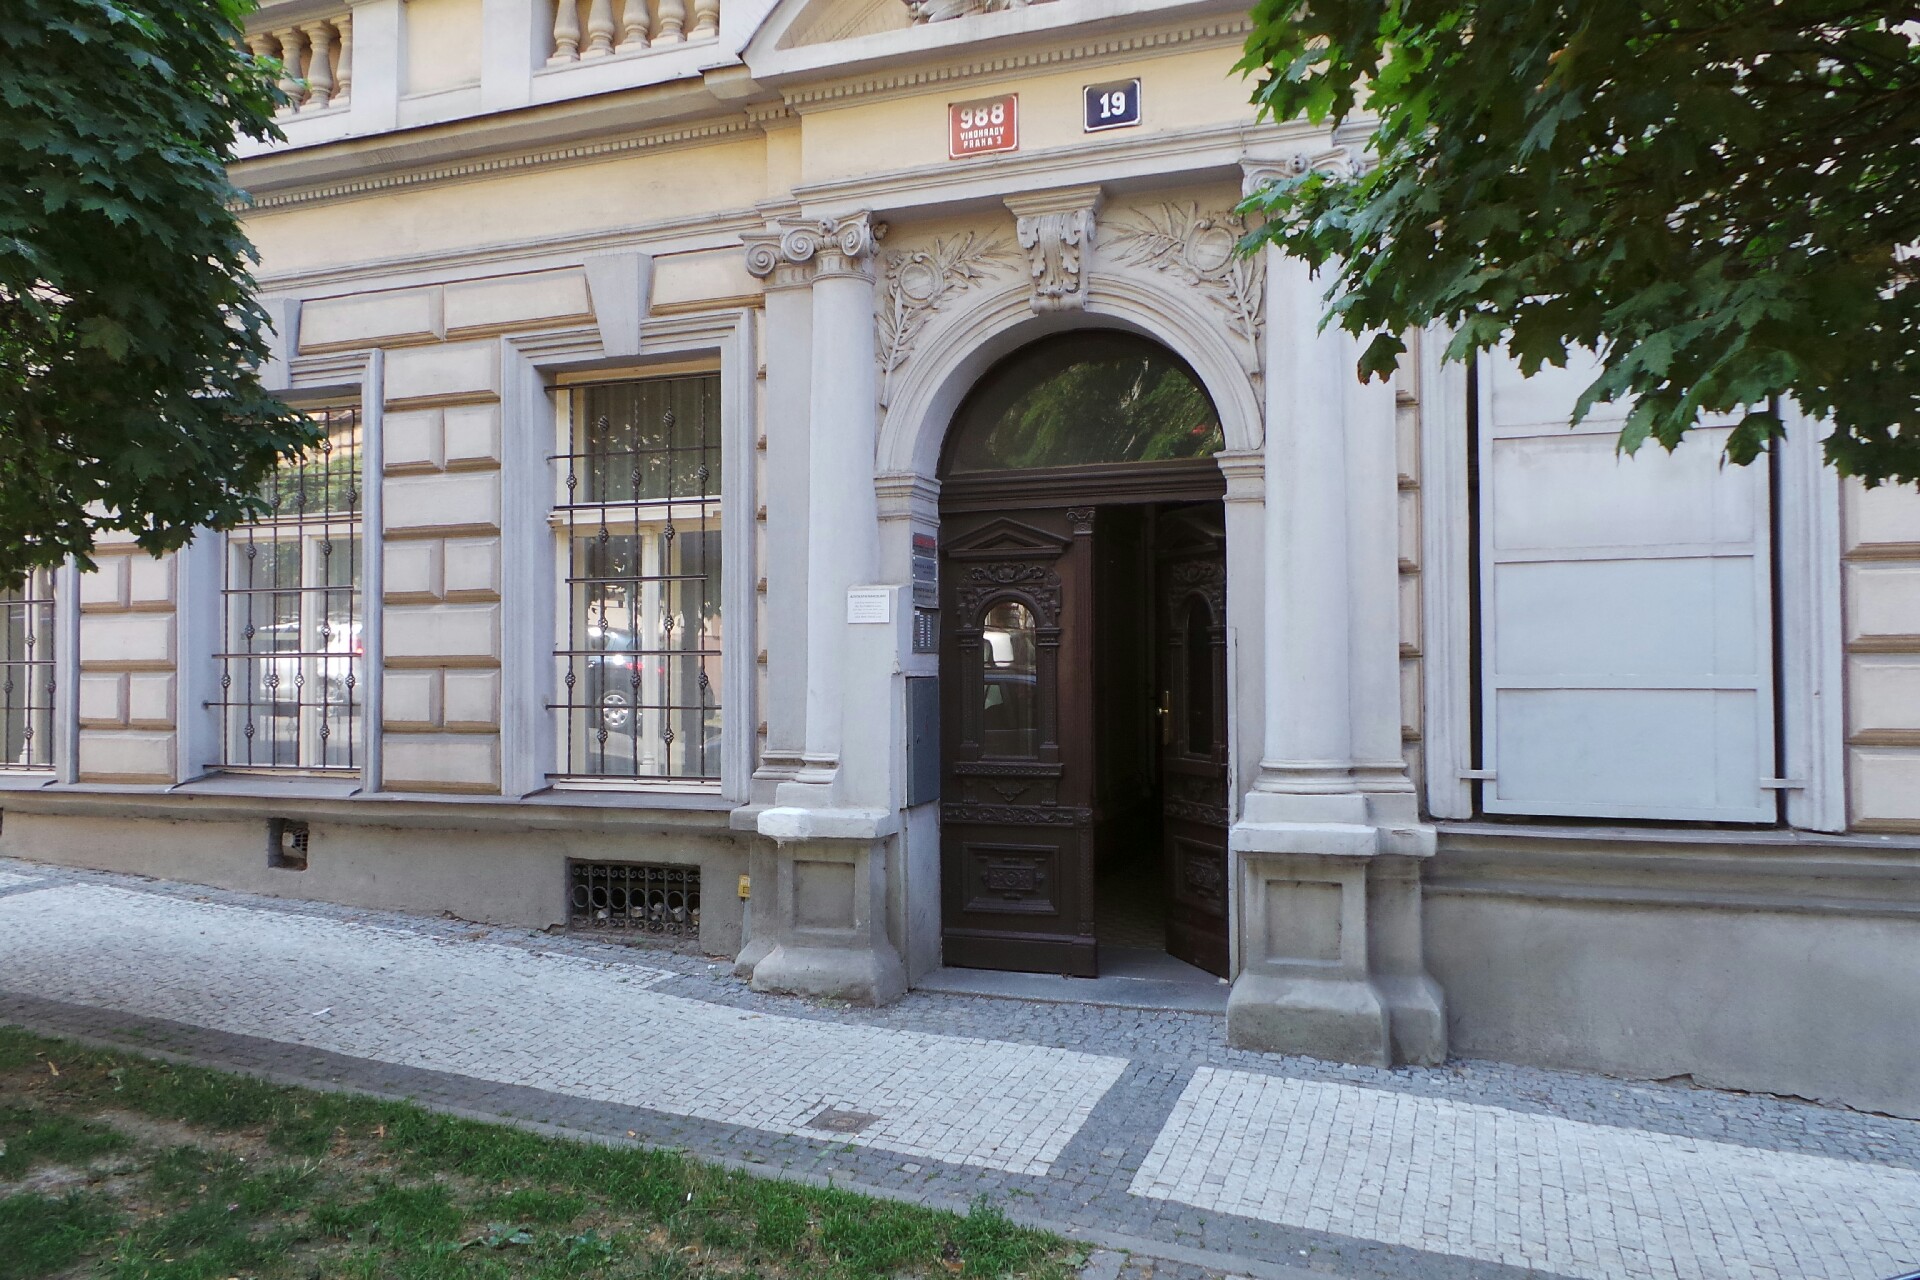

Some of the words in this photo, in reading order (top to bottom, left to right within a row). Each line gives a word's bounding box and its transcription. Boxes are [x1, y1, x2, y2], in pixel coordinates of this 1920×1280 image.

[1100, 91, 1126, 119] 19
[960, 103, 1004, 129] 988
[960, 126, 1004, 141] VINOHRADY
[963, 137, 993, 149] PRAHA
[996, 136, 1002, 145] 3
